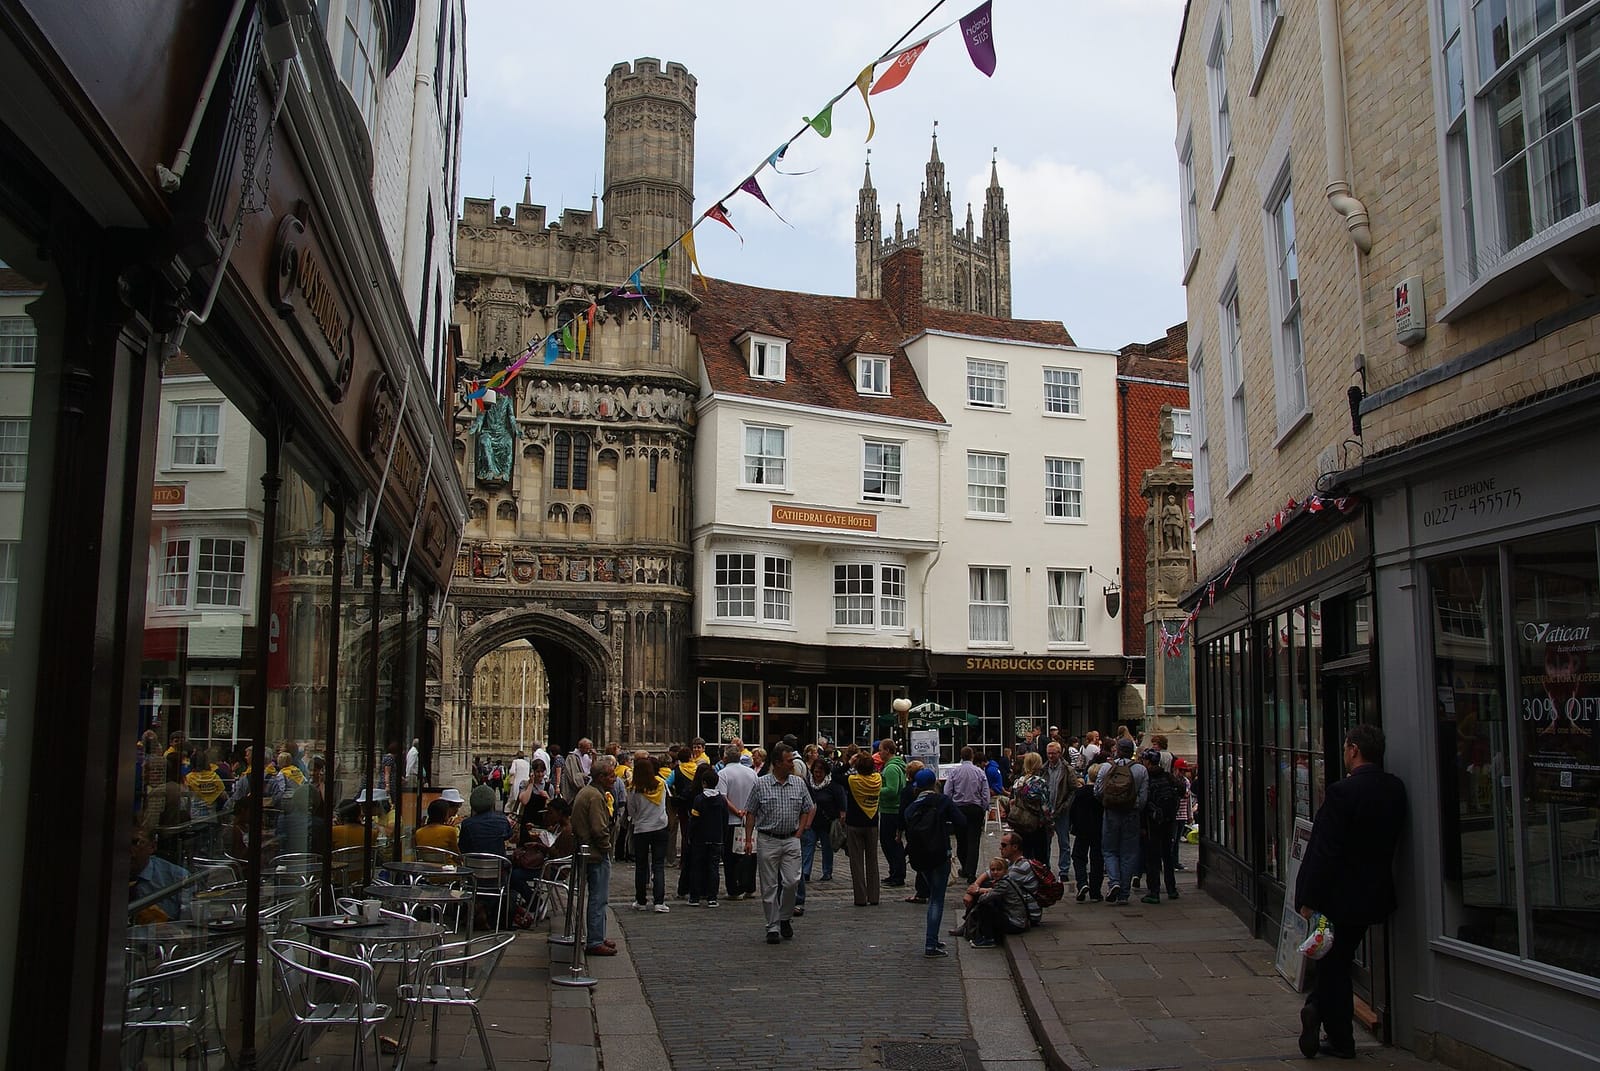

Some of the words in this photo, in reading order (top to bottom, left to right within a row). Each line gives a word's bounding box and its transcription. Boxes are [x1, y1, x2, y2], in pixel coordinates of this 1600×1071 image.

[1442, 478, 1496, 502] TELEPHONE
[776, 509, 824, 523] CATHEDRAL
[825, 514, 847, 525] GATE
[848, 516, 872, 527] HOTEL
[1424, 504, 1457, 527] 01227
[1469, 487, 1522, 516] 455575
[1303, 549, 1313, 576] OF
[1316, 527, 1355, 570] LONDON
[1523, 622, 1590, 644] Vatican
[966, 658, 1044, 671] STARBUCKS
[1047, 659, 1095, 671] COFFEE
[1522, 698, 1558, 720] 30%
